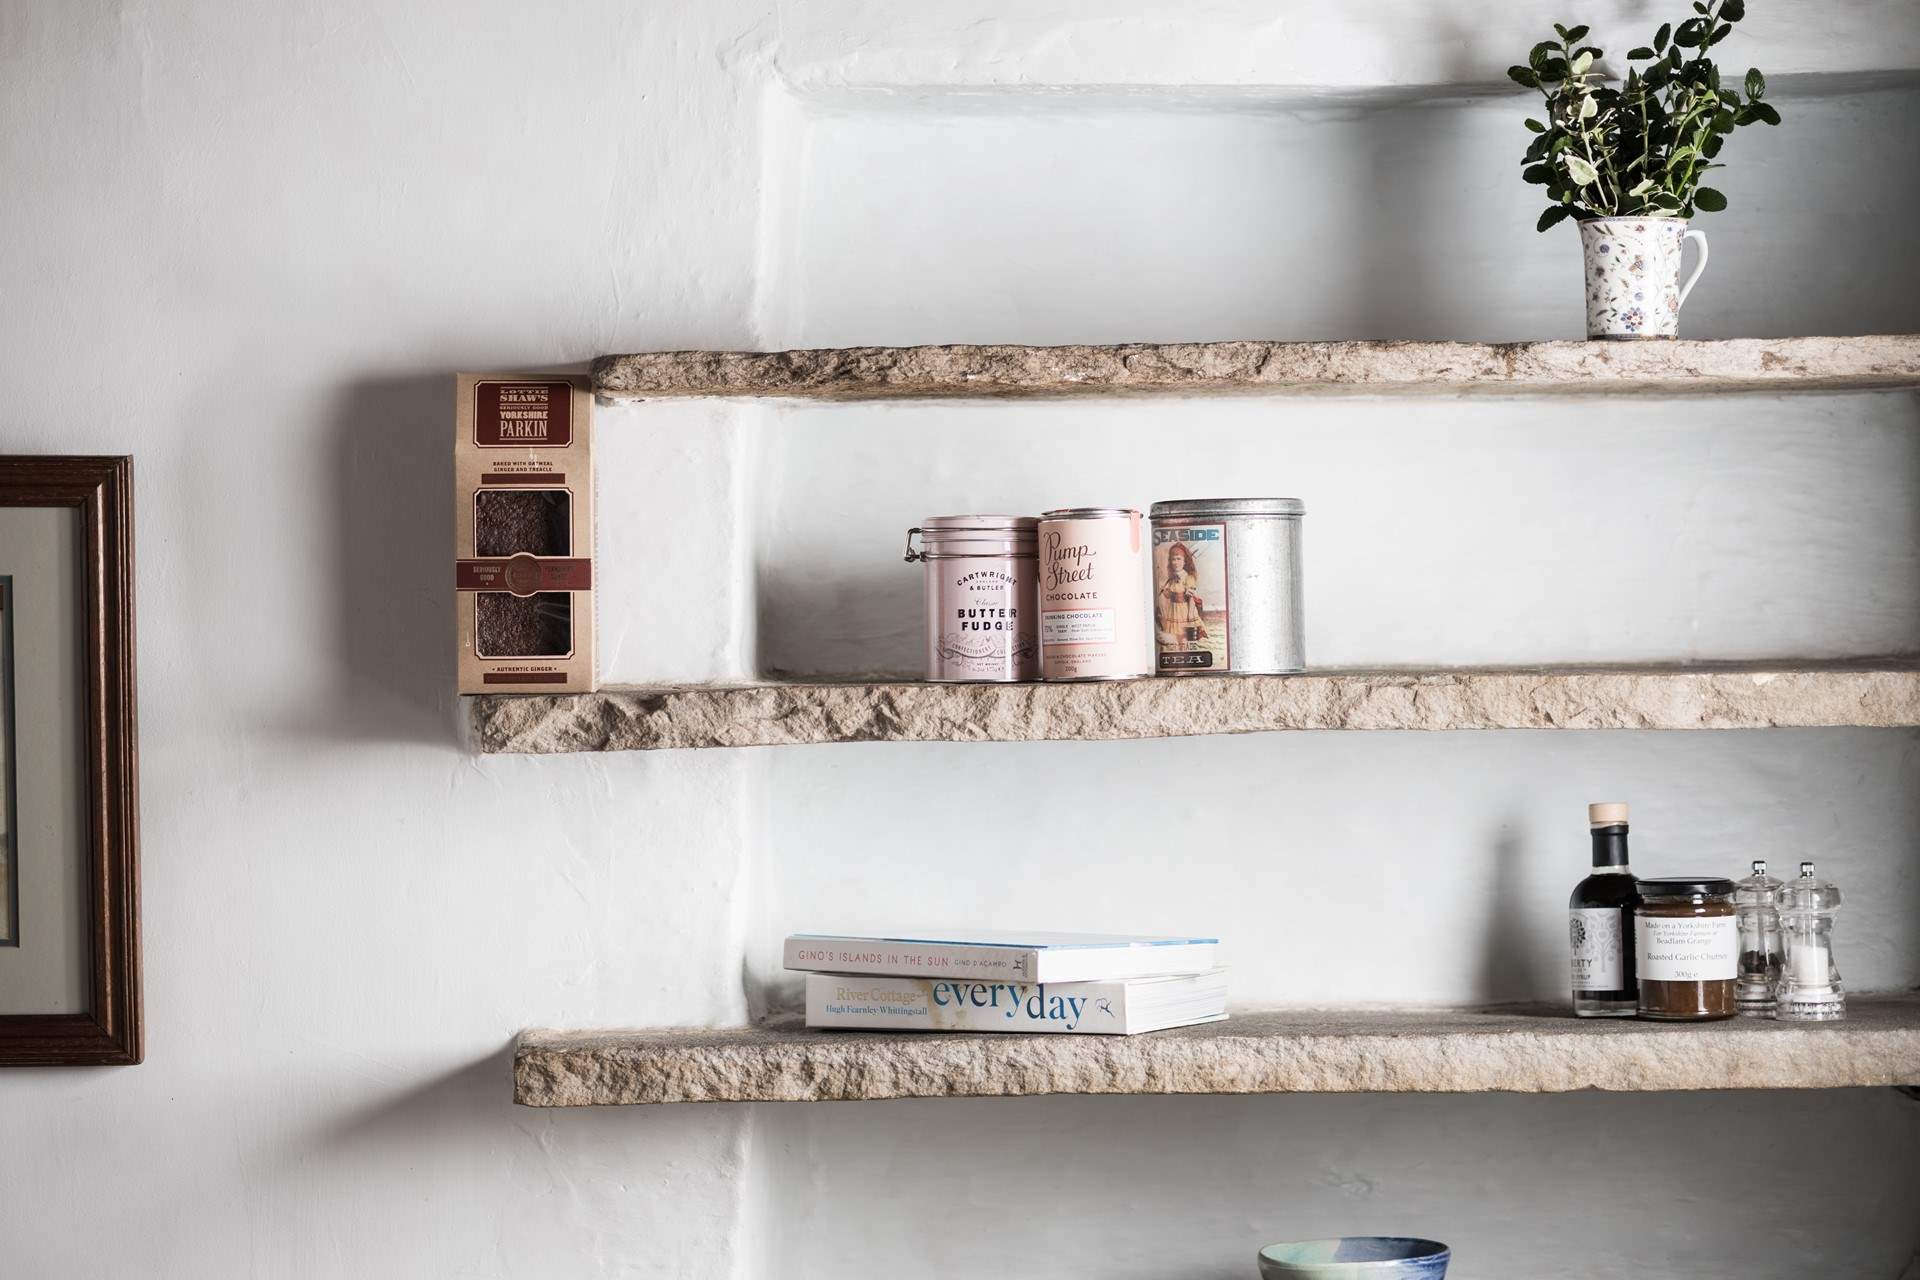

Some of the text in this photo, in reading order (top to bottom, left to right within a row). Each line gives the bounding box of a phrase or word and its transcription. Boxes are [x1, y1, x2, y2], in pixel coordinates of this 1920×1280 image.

[500, 411, 548, 419] YORKSHIRE
[500, 421, 547, 436] PARKIN
[1152, 528, 1220, 546] SEASIDE
[1044, 531, 1096, 566] Pump
[957, 571, 1017, 586] CARTWRIGHT
[1047, 562, 1094, 591] Street
[1046, 592, 1098, 601] CHOCOLATE
[958, 608, 1017, 618] BUTTER
[961, 621, 1014, 631] FUDGE
[1162, 656, 1204, 664] TEA
[798, 951, 834, 961] GINO'S
[839, 952, 883, 963] ISLANDS
[887, 955, 898, 964] IN
[904, 955, 922, 966] THE
[927, 956, 949, 967] SUN
[1647, 952, 1673, 961] Roasted
[1675, 952, 1700, 961] Garlic
[836, 987, 916, 1005] River Cottage
[826, 1004, 846, 1014] Hugh
[933, 981, 1087, 1030] everyday
